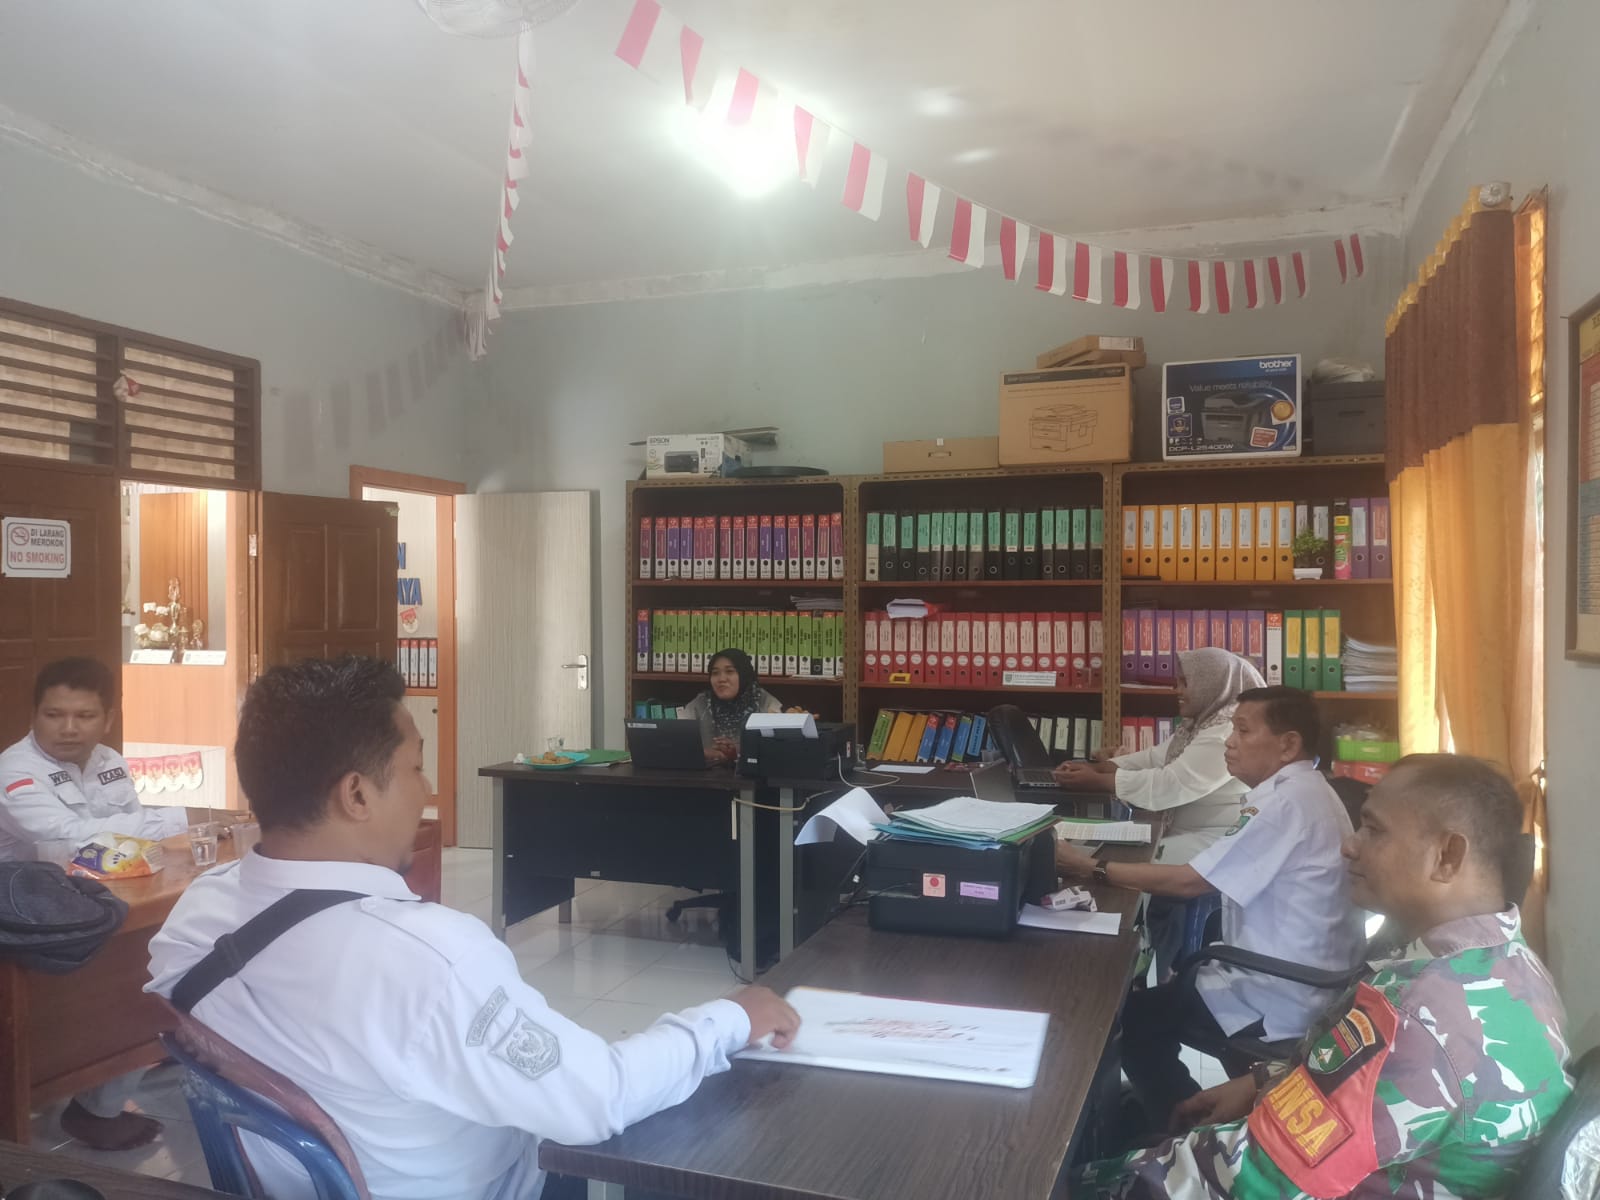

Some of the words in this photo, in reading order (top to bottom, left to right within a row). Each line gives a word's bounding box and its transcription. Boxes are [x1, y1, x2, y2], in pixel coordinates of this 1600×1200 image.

[1259, 360, 1293, 369] brother
[1189, 383, 1212, 393] Value
[30, 528, 38, 537] DI
[40, 528, 65, 538] LARANG
[30, 537, 65, 547] MEROKOK
[10, 551, 23, 562] NO
[26, 551, 65, 564] SMOKING
